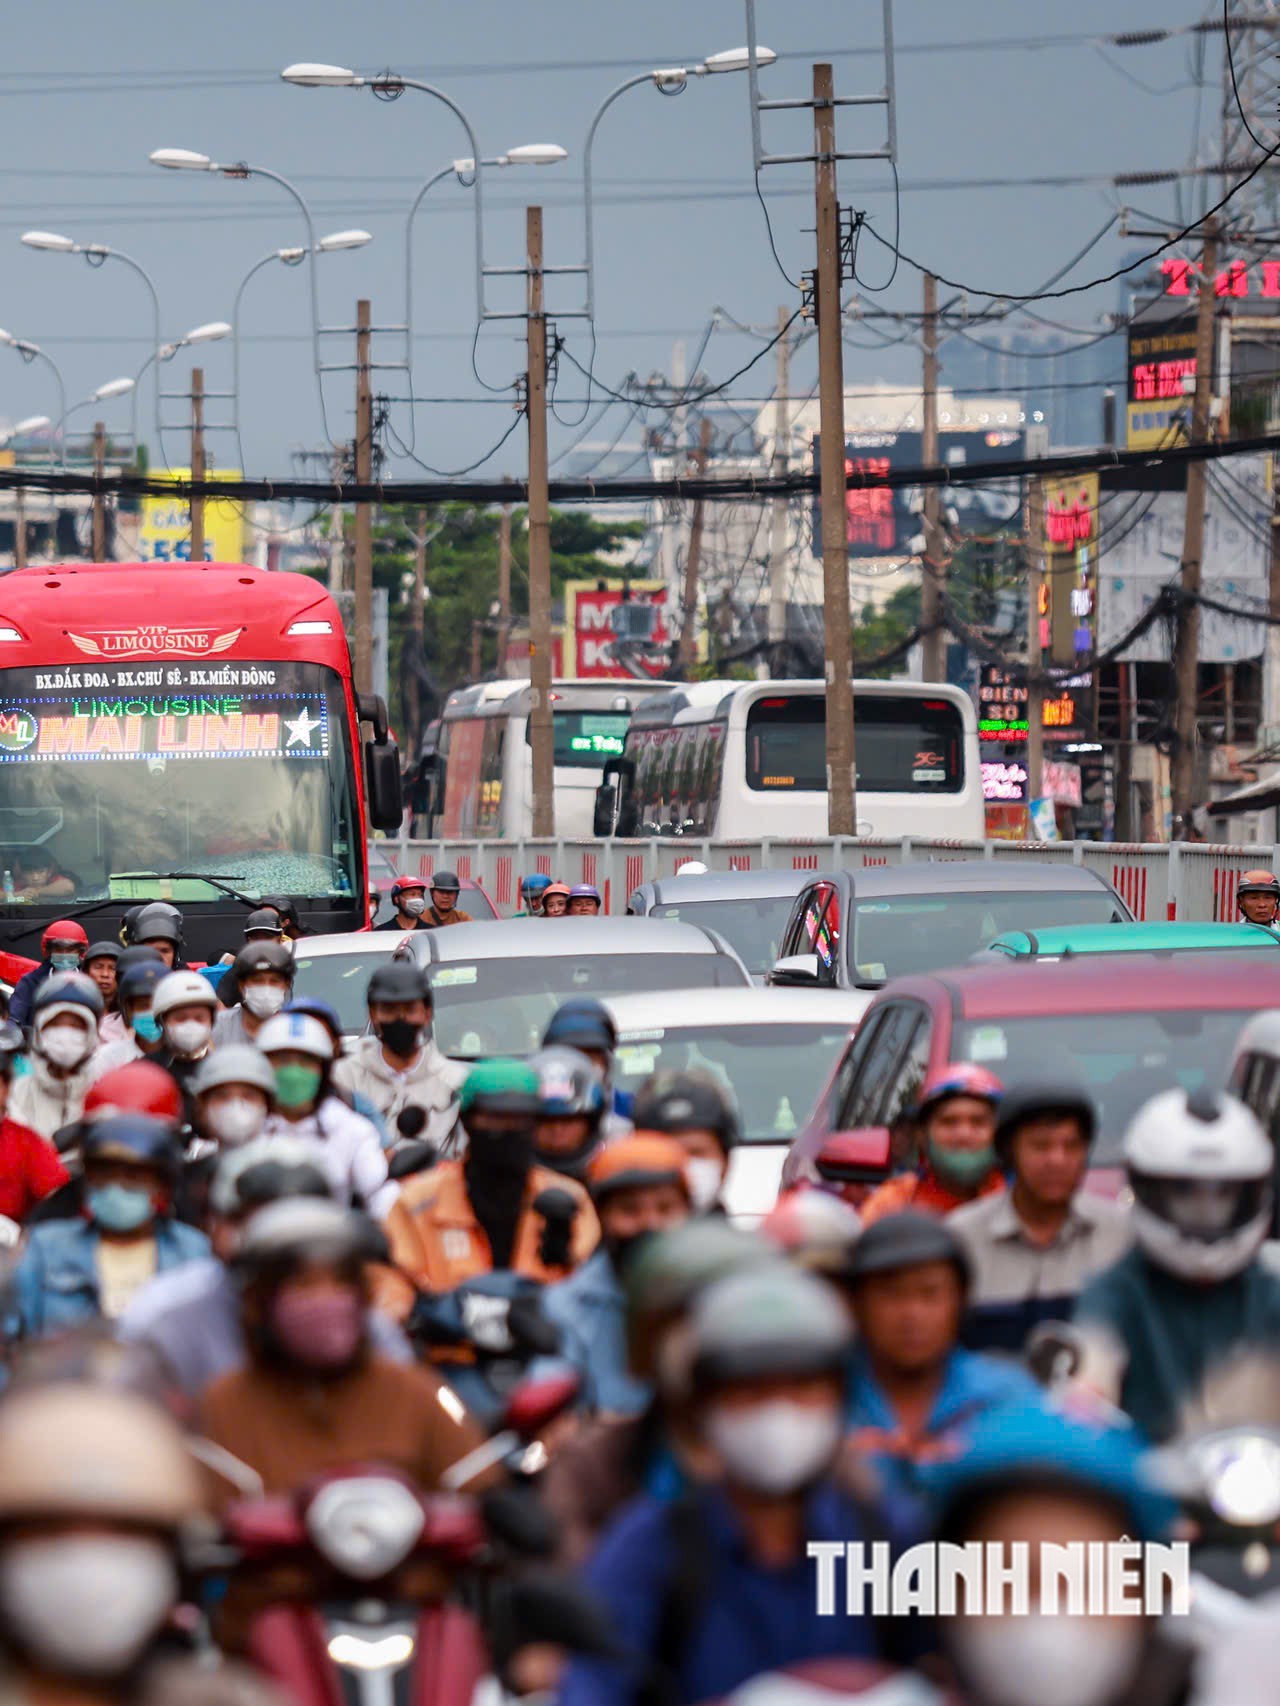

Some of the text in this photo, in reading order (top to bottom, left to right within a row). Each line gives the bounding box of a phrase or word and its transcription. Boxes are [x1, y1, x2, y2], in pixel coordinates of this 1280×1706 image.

[137, 626, 168, 635] VIP
[103, 634, 209, 651] LIMOUSINE
[36, 664, 277, 689] BX.ĐẮK ĐOA BX.CHƯ SÊ BX.MIỀN ĐÔNG
[73, 699, 242, 718] LIMOUSINE
[37, 715, 142, 753] MAI
[156, 713, 280, 751] LINH
